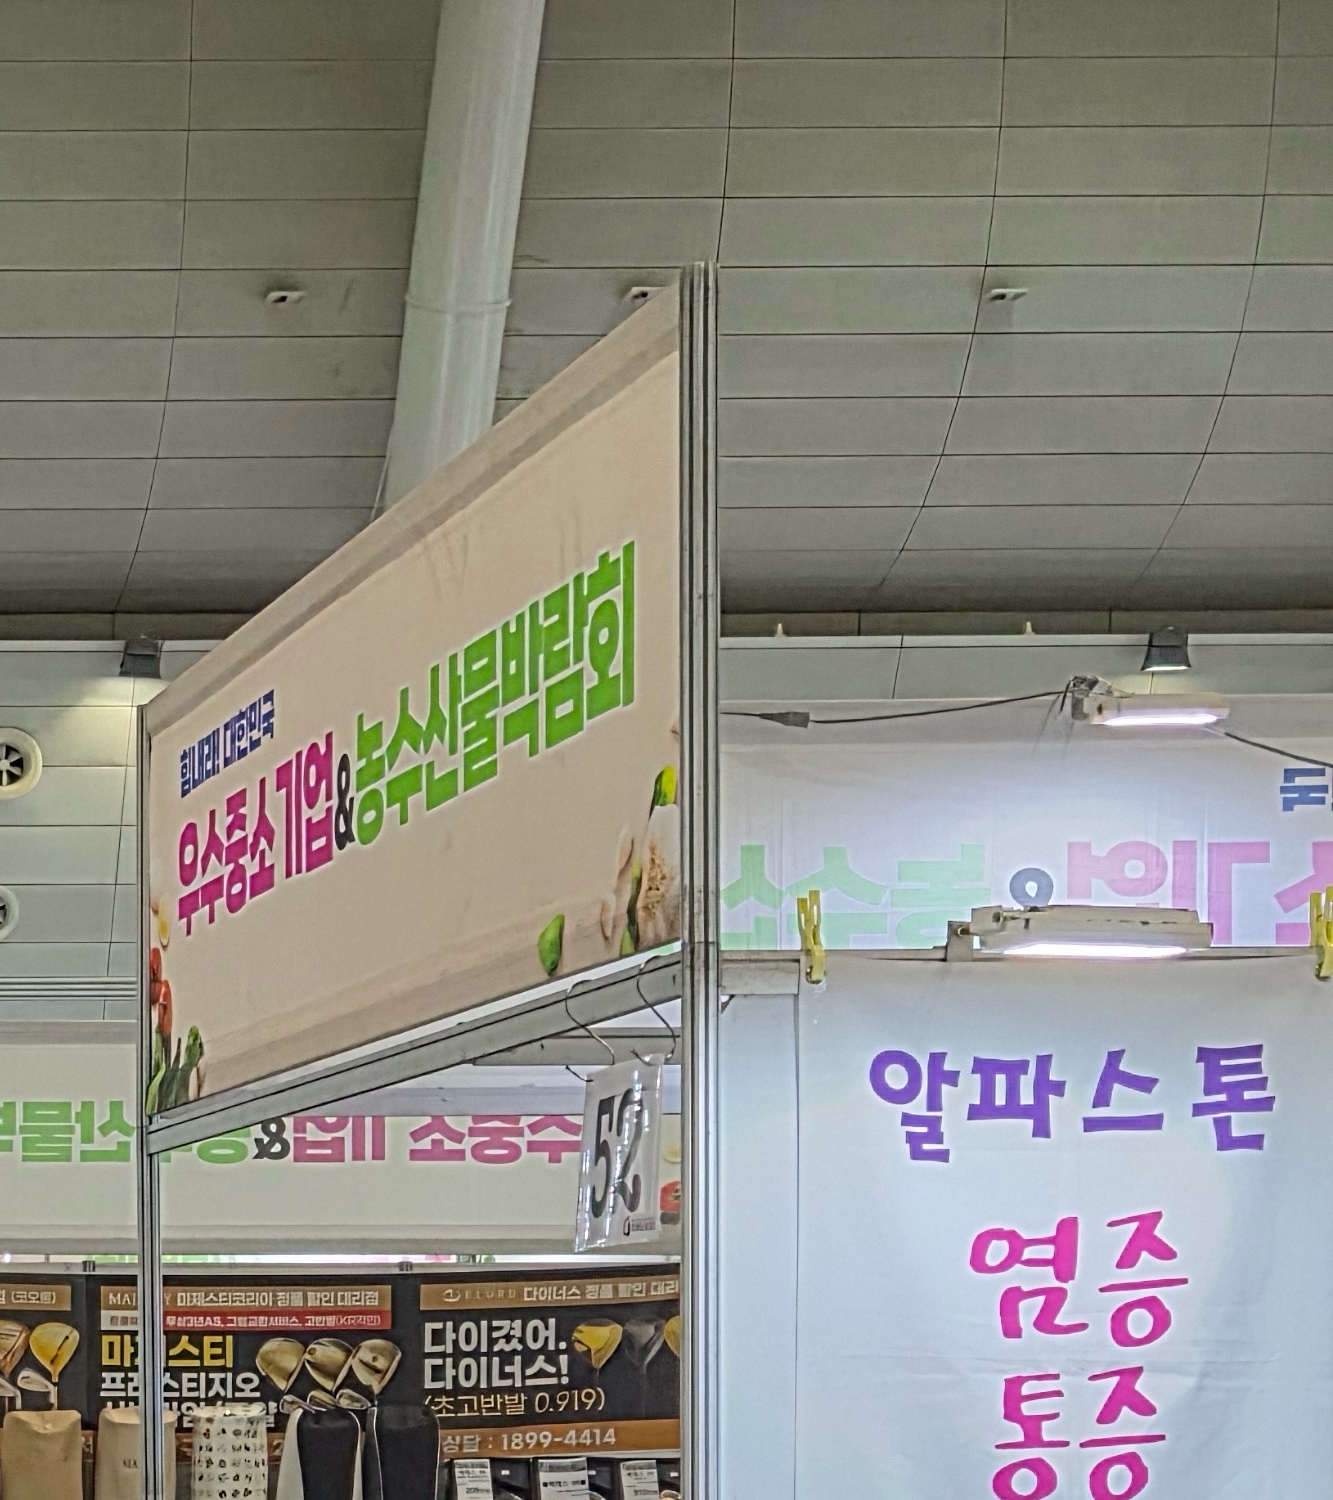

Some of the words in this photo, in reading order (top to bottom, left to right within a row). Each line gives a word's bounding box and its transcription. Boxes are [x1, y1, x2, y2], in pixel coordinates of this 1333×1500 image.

[180, 732, 221, 799] 힘내라!
[222, 688, 276, 770] 대한민국
[178, 776, 276, 936] 우수중소
[869, 1043, 1276, 1164] 알파스톤
[523, 1284, 582, 1302] 다이너스
[968, 1210, 1189, 1348] 염증
[337, 1290, 380, 1306] 대리점
[423, 1317, 568, 1354] 다이겼어.
[423, 1354, 570, 1390] 다이너스!
[534, 1386, 606, 1414] 0.919)
[500, 1427, 617, 1451] 1899-4414
